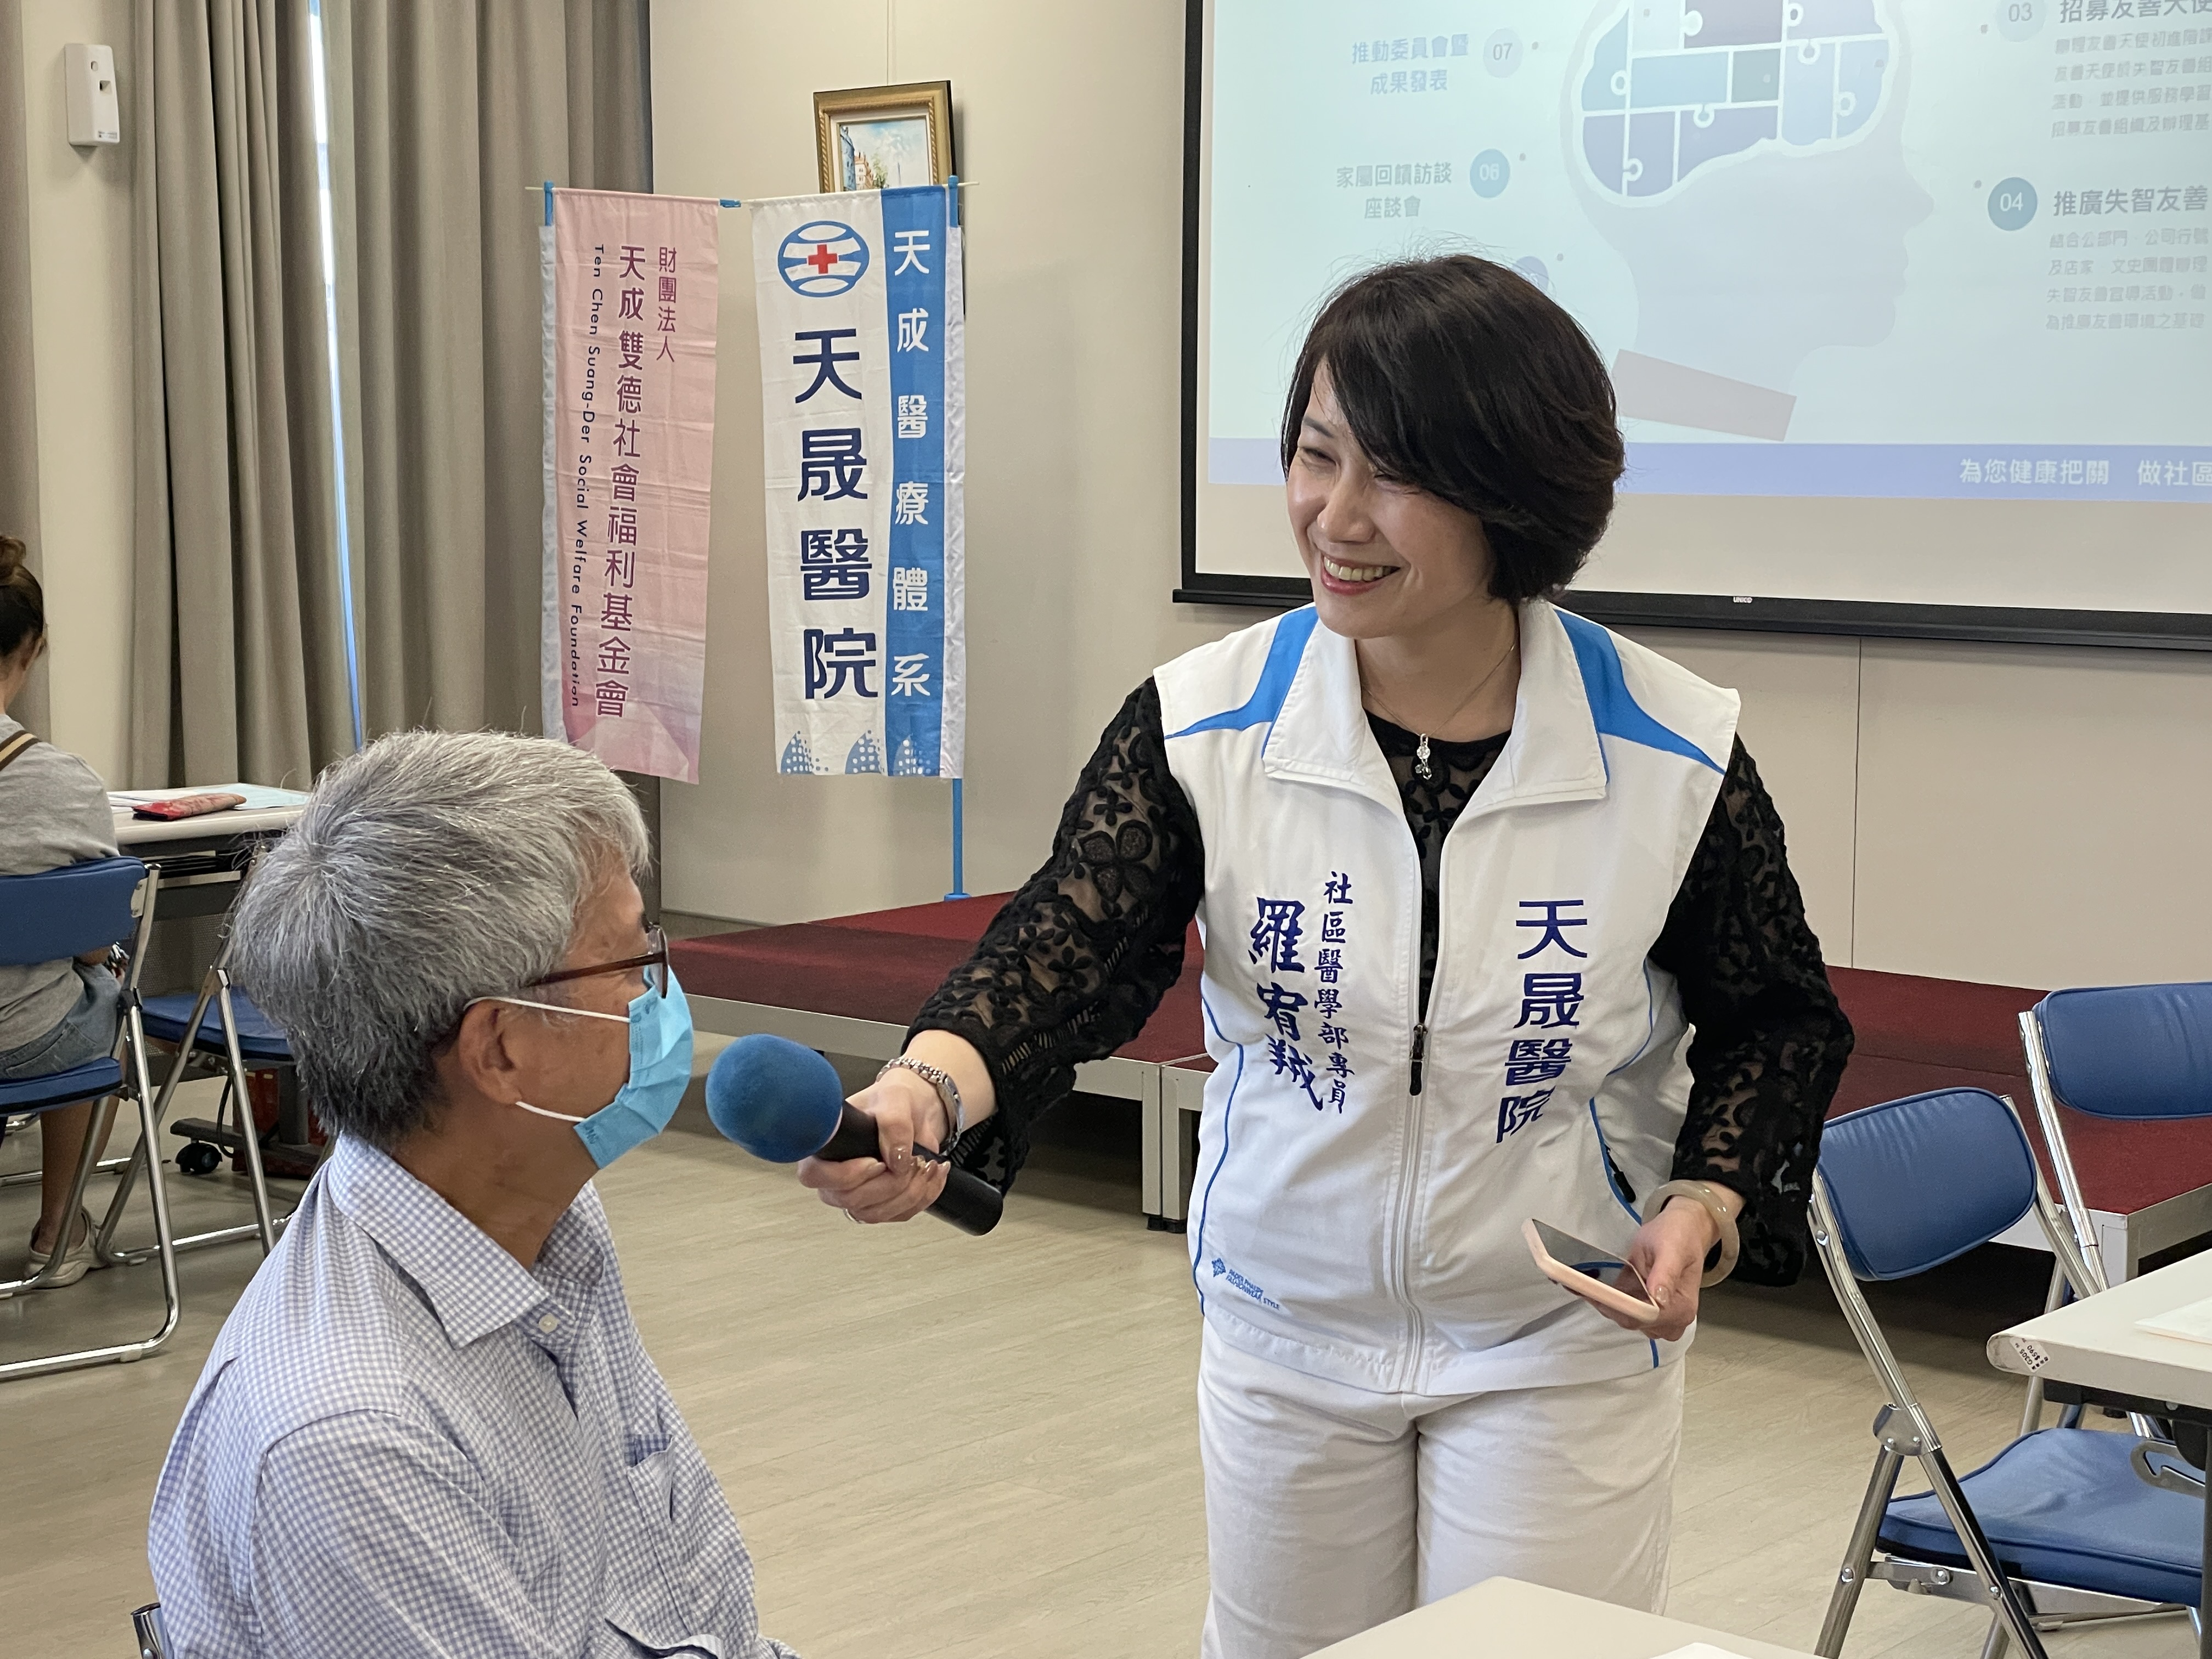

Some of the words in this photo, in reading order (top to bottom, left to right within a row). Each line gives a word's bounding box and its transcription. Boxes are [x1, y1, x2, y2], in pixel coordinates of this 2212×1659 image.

[2008, 4, 2033, 22] 03
[1493, 43, 1513, 61] 07
[1370, 69, 1448, 95] 成果發表
[1480, 162, 1500, 180] 06
[1364, 195, 1421, 219] 座談會
[2000, 193, 2024, 212] 04
[2053, 185, 2208, 217] 推廣失智友善
[593, 244, 604, 278] Ten
[589, 289, 603, 335] Chen
[656, 246, 678, 363] 財團法人
[581, 346, 600, 443] Suang-Der
[577, 454, 592, 509] Social
[596, 245, 646, 718] 天成雙德社會福利基金會
[891, 230, 930, 697] 天成醫療體系
[1959, 458, 2110, 486] 為您健康把關
[793, 328, 878, 699] 天晟醫院
[572, 520, 588, 594] Welfare
[569, 605, 582, 707] Foundation
[1314, 871, 1355, 1114] 社區醫學部專員
[1496, 899, 1588, 1144] 天晟醫院
[1263, 1297, 1280, 1310] STYLE
